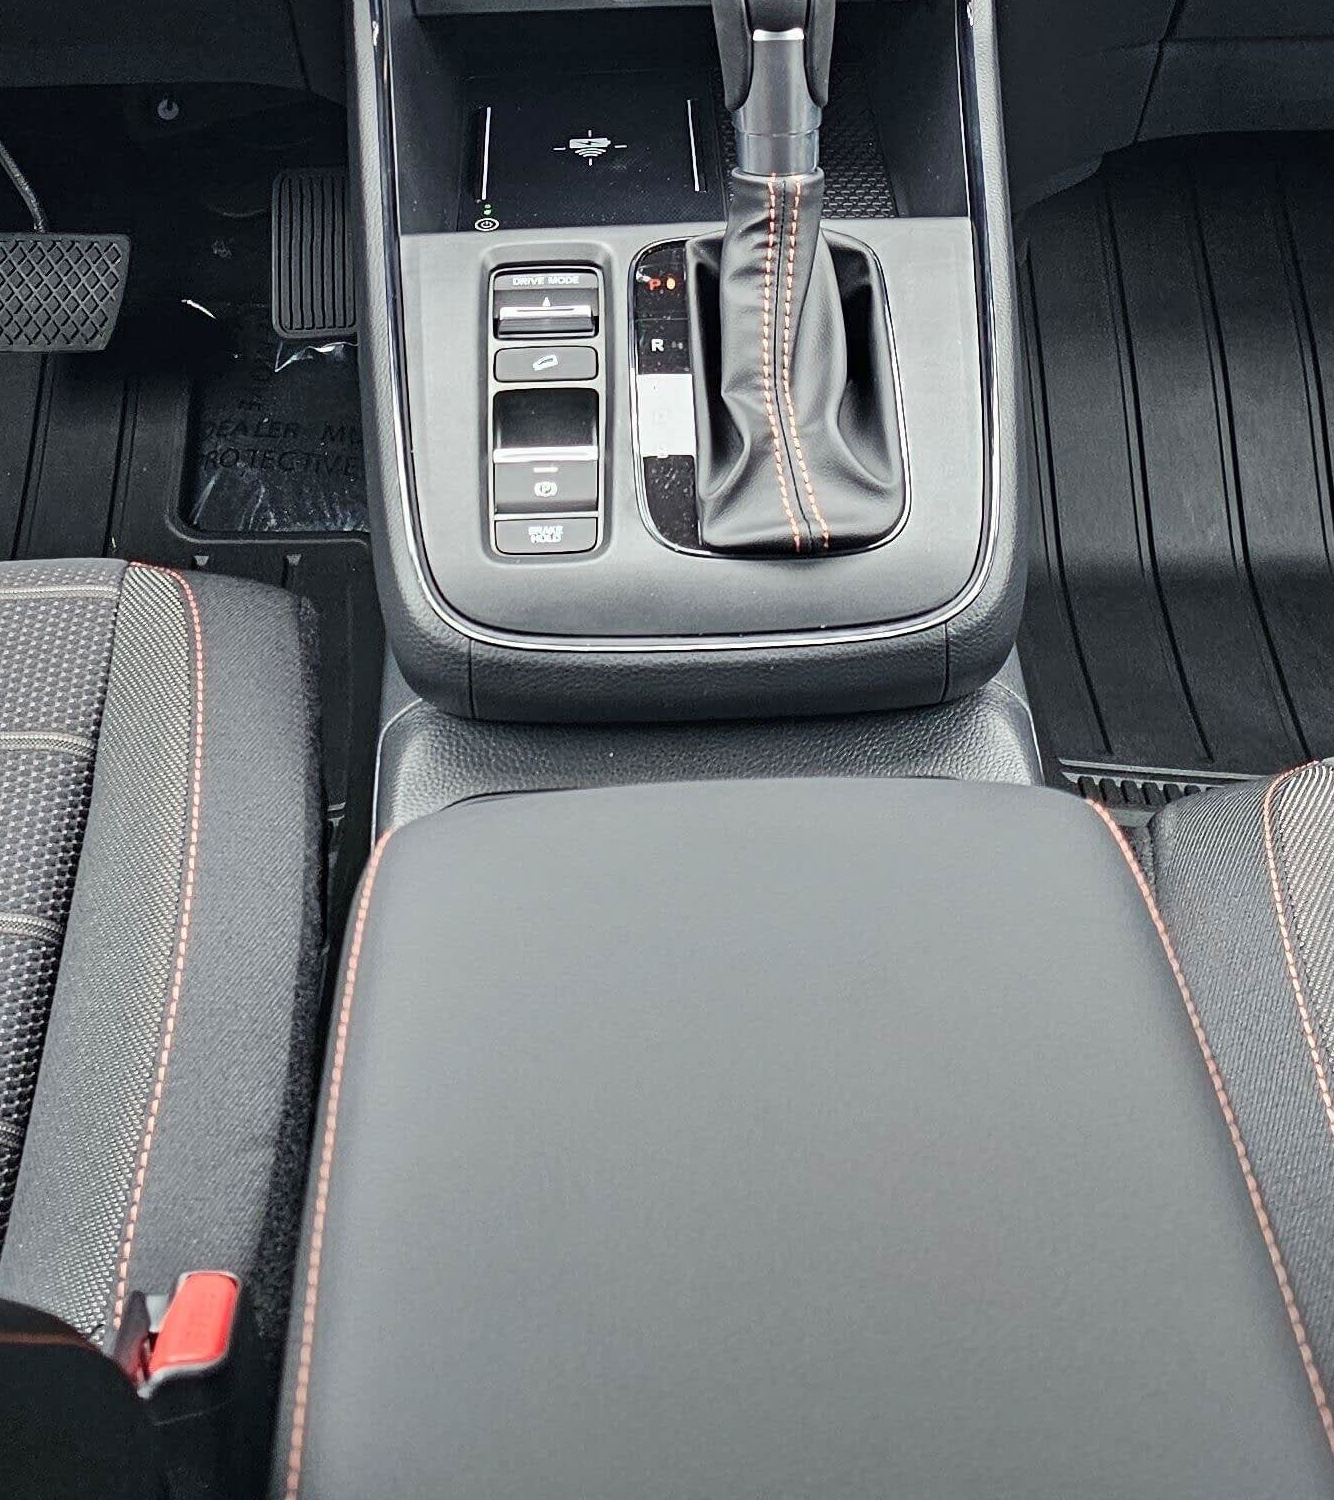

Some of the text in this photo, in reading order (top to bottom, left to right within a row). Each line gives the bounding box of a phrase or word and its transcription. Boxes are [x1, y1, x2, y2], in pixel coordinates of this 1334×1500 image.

[512, 276, 579, 285] DRIVE MODE
[649, 278, 661, 290] P
[651, 338, 664, 351] R
[528, 526, 563, 535] BRAKE
[531, 534, 561, 543] HOLD
